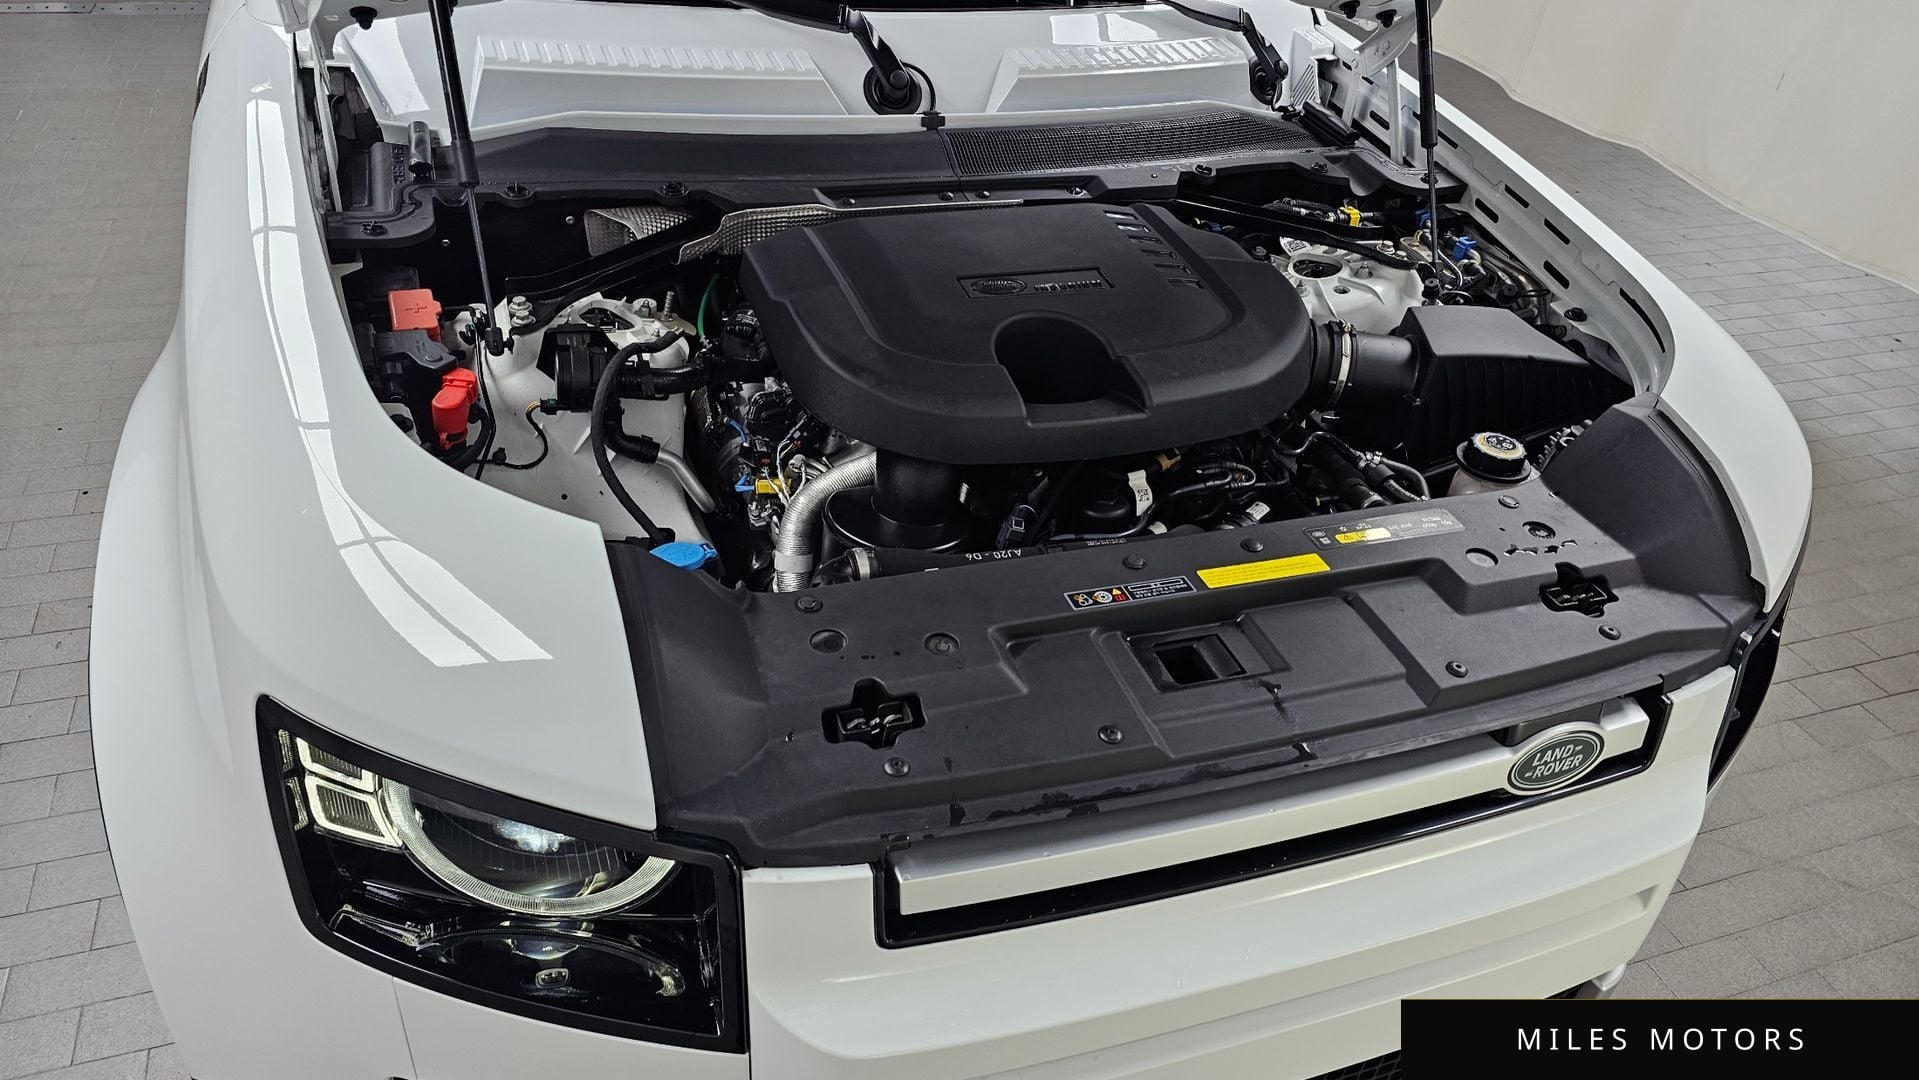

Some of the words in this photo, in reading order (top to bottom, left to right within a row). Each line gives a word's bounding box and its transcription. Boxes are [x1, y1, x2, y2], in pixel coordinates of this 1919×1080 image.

[965, 552, 983, 561] D6
[993, 548, 1022, 559] AJ20
[1531, 744, 1574, 767] LAND
[1532, 754, 1584, 779] ROVER
